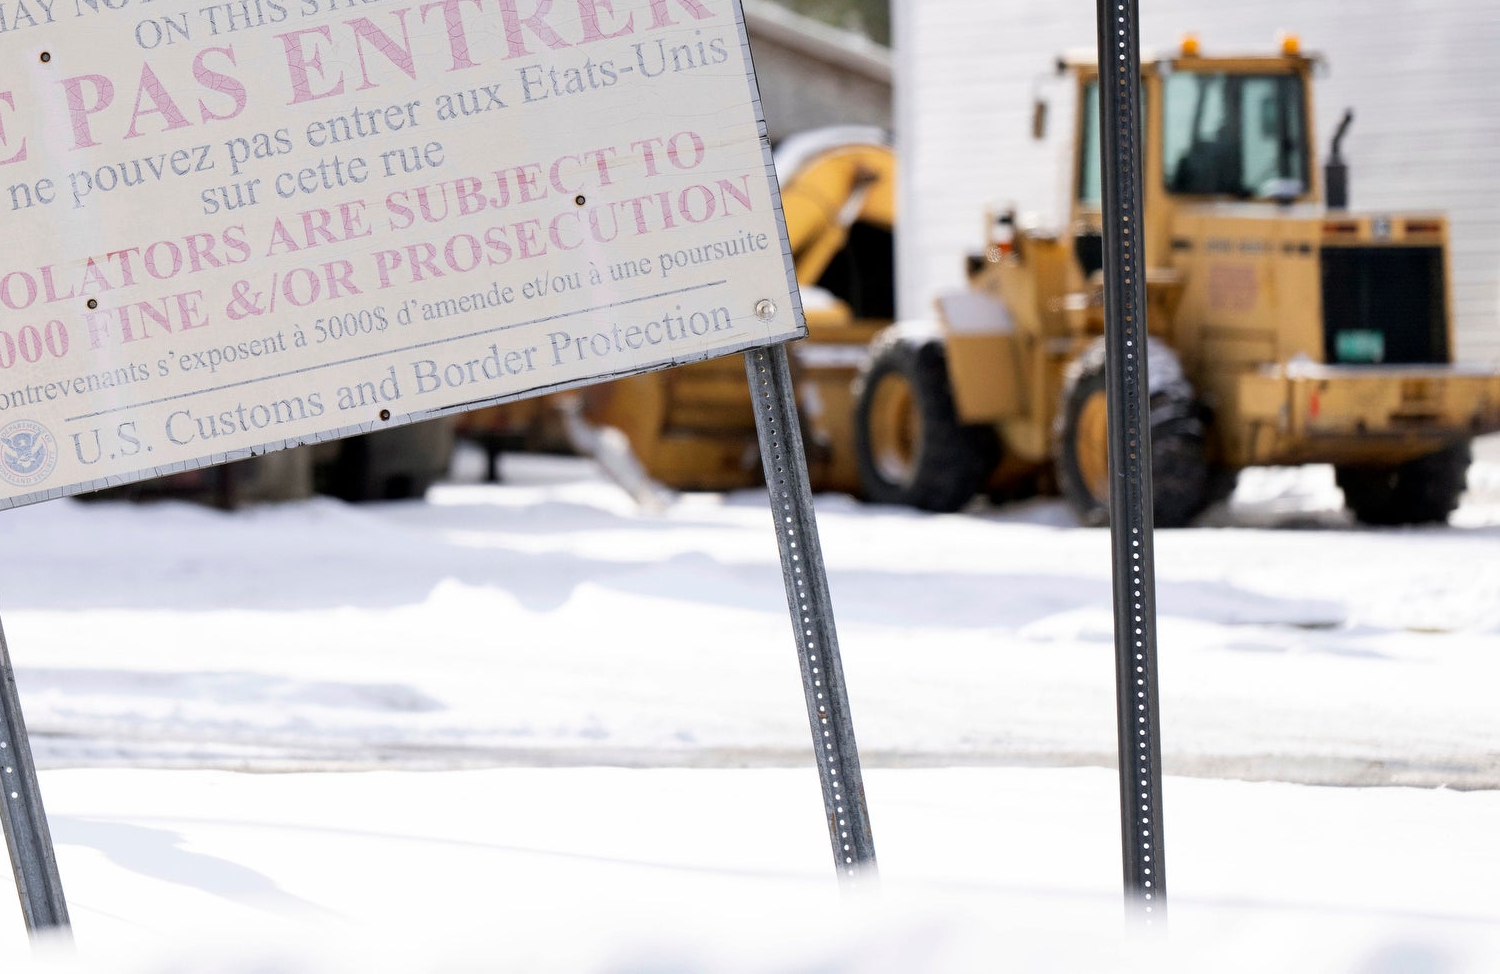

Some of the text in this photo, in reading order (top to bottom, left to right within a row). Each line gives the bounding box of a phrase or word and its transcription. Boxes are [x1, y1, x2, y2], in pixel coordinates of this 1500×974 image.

[134, 11, 191, 50] ON
[7, 177, 56, 211] ne
[68, 144, 215, 210] pouvez
[224, 127, 293, 176] pas
[306, 100, 420, 148] entrer
[435, 83, 509, 122] aux
[516, 29, 729, 104] Etats-Unis
[54, 43, 248, 152] PAS
[201, 140, 445, 215] sur cette rue
[265, 199, 373, 258] ARE
[385, 146, 617, 232] SUBJECT
[630, 130, 706, 178] TO
[81, 289, 210, 351] FINE
[226, 259, 364, 321] &/OR
[371, 174, 754, 290] PROSECUTION
[293, 323, 308, 349] à
[314, 305, 390, 344] 5000$
[522, 269, 582, 300] et/ou
[589, 261, 602, 286] à
[610, 256, 653, 282] une
[658, 229, 770, 278] poursuite
[68, 303, 735, 466] U.S. Customs and Border Protection
